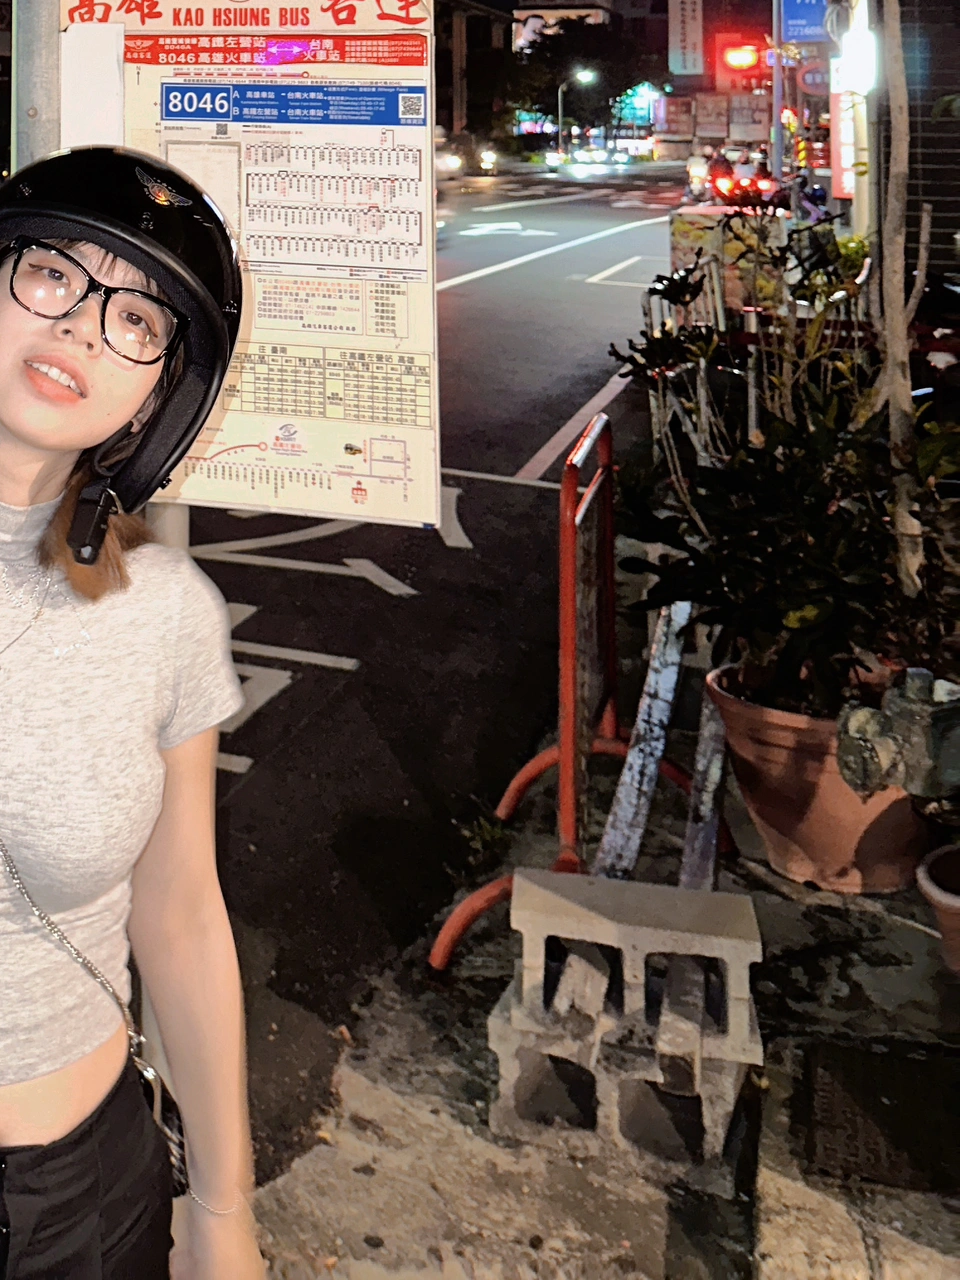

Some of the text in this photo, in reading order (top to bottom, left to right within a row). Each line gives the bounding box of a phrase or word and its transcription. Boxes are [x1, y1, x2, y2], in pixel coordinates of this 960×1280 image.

[172, 7, 311, 27] KAO HSIUNG BUS
[198, 36, 266, 49] 高鐵左營站
[309, 38, 334, 50] 台南
[158, 51, 267, 64] 8046 高雄火車站
[303, 49, 341, 62] 火車站
[232, 90, 240, 99] A
[168, 91, 229, 113] 8046
[232, 107, 240, 115] B
